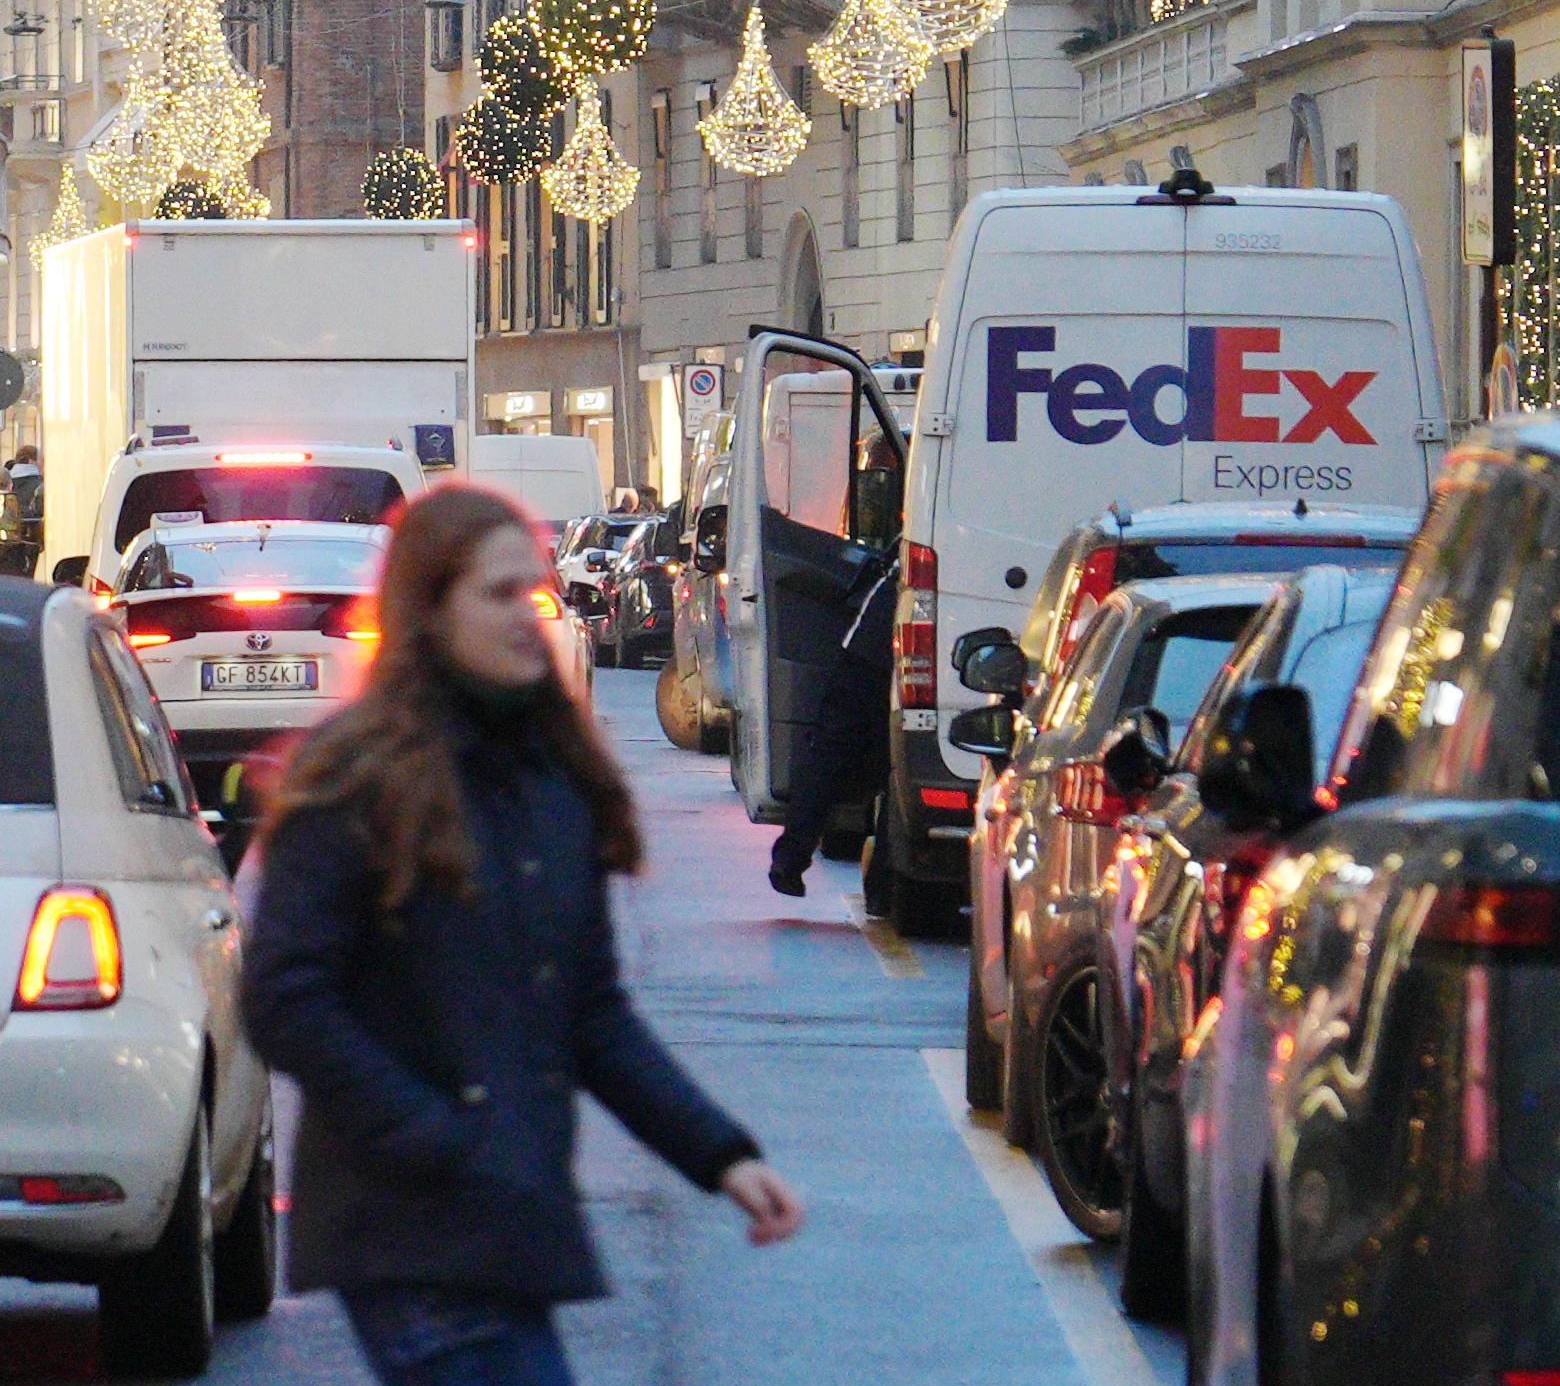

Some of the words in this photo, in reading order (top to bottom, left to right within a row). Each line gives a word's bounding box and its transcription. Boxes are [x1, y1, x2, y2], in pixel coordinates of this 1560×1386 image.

[986, 326, 1379, 446] FedEx
[1213, 456, 1353, 496] Express
[216, 666, 239, 684] GF
